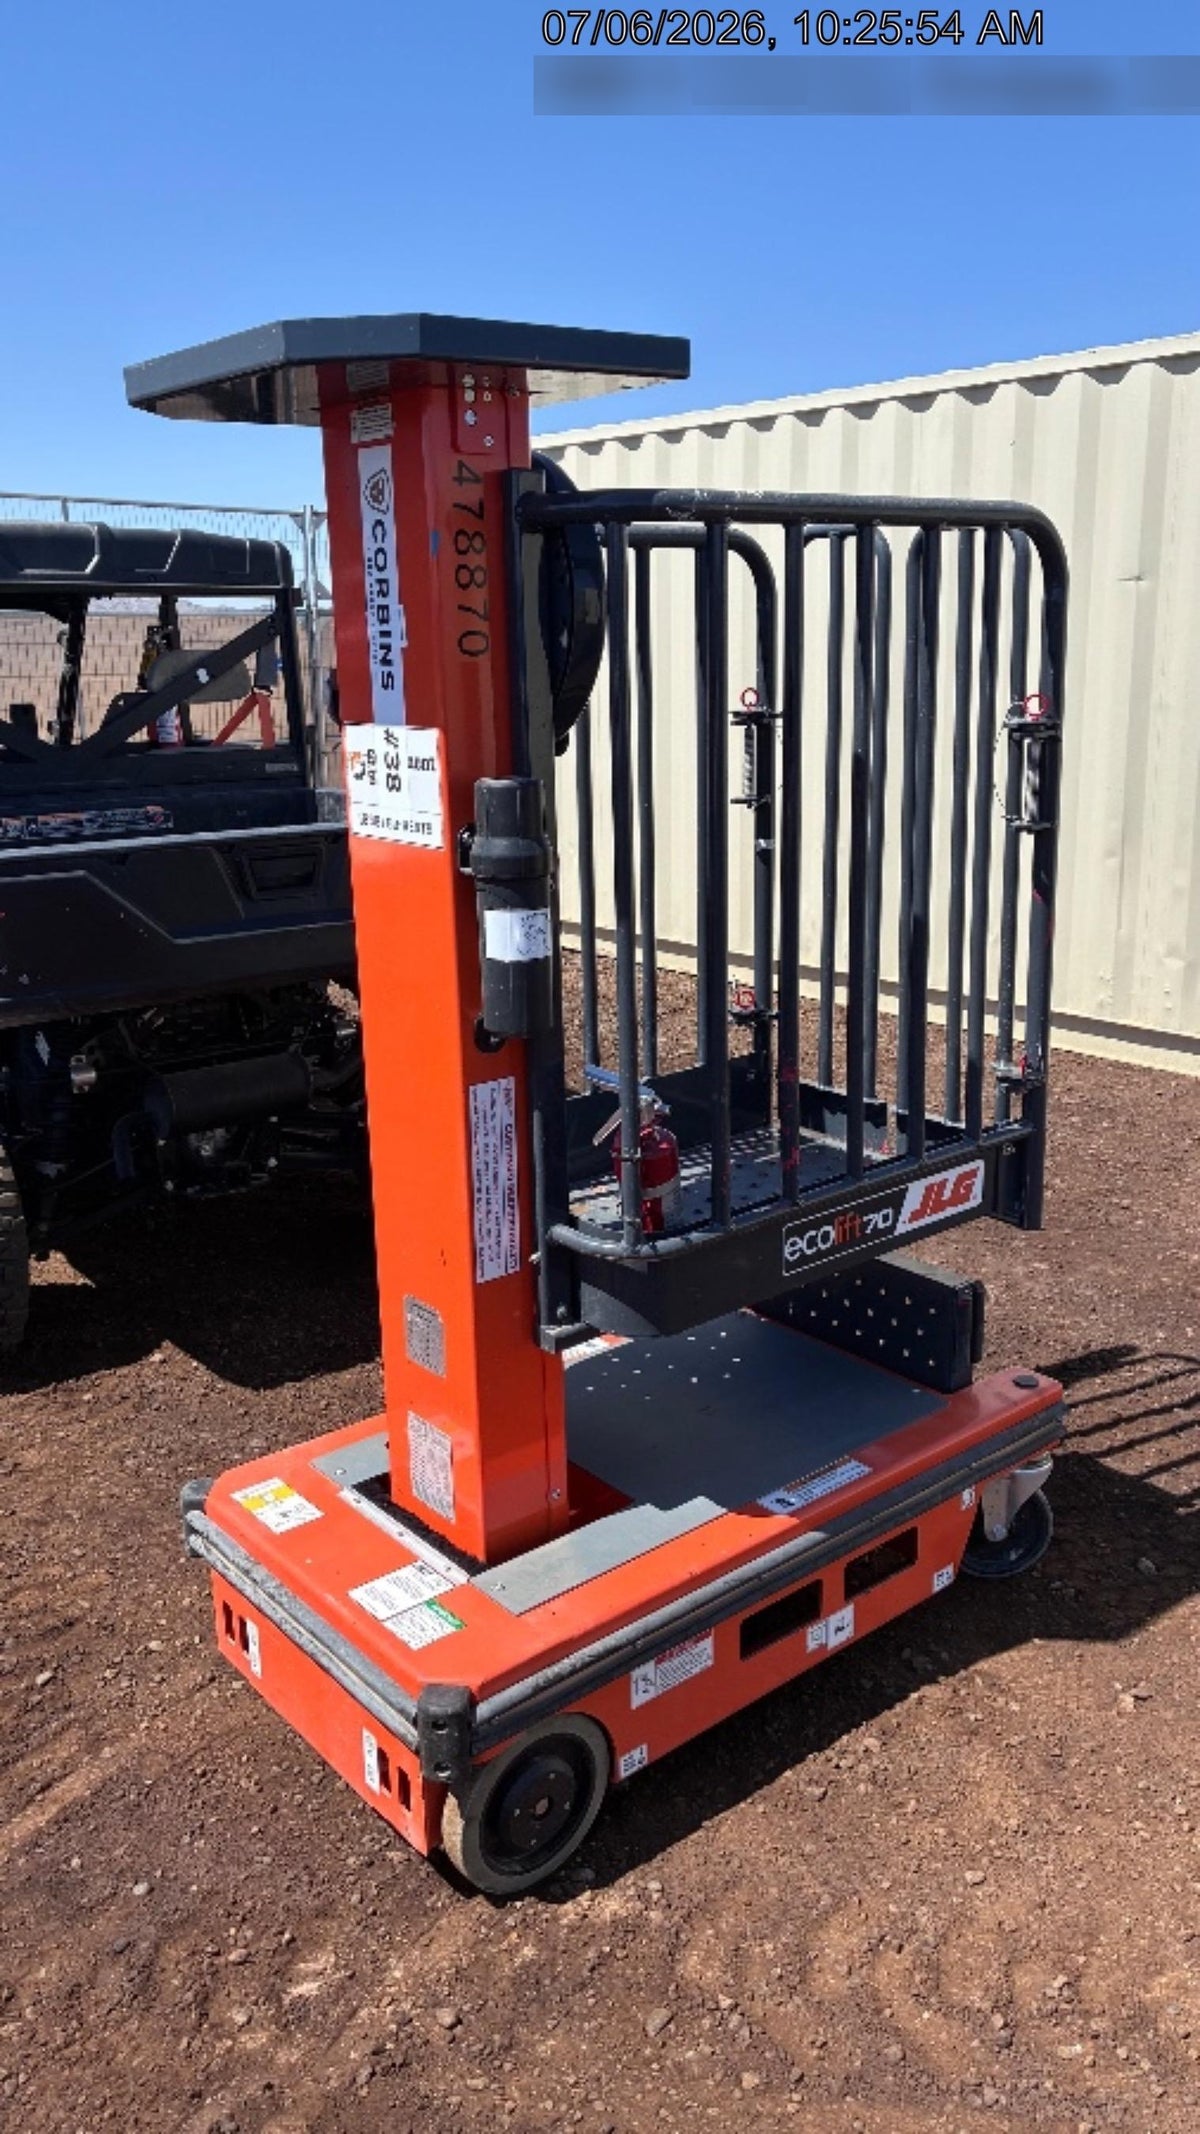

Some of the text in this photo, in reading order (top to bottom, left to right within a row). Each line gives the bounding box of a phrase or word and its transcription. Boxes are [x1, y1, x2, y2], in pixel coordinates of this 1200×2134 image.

[371, 518, 395, 692] CORBINS
[452, 458, 490, 658] 478870
[383, 727, 402, 793] #38
[907, 1168, 978, 1224] JLG
